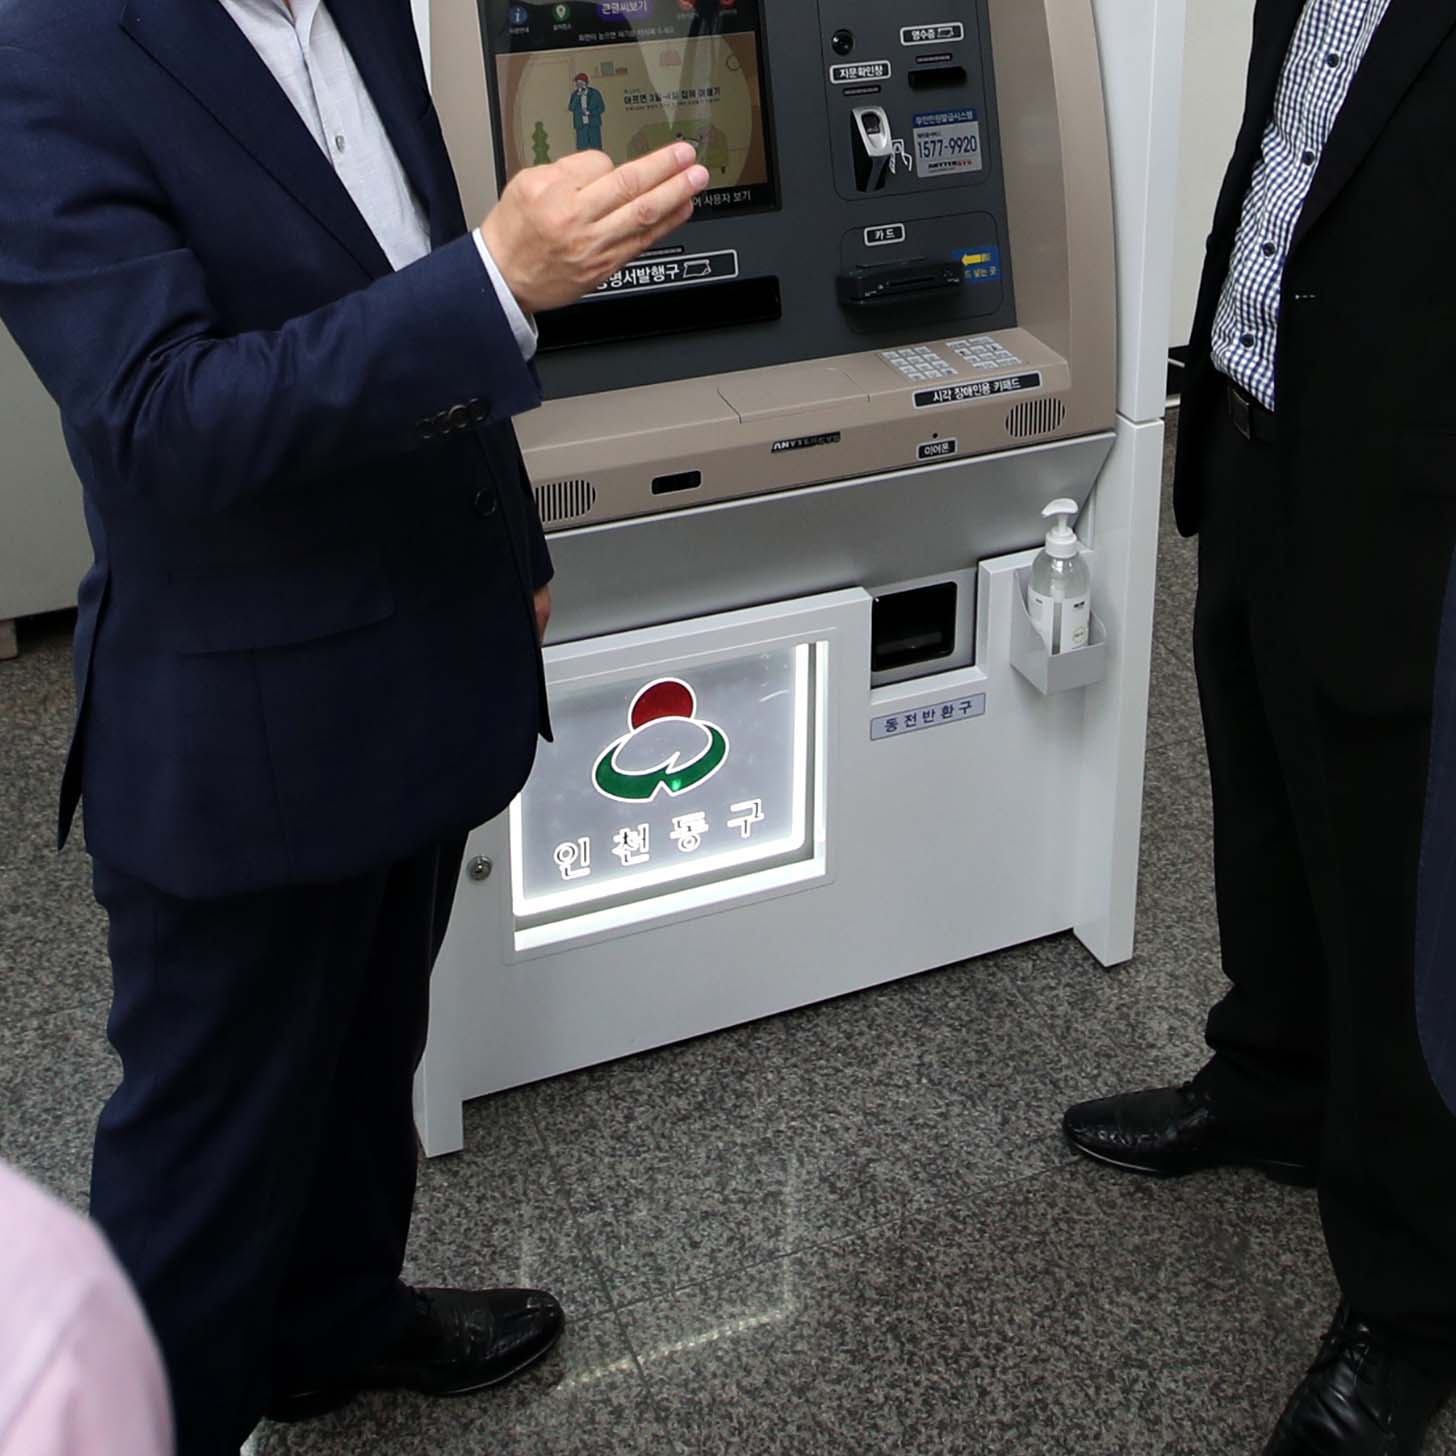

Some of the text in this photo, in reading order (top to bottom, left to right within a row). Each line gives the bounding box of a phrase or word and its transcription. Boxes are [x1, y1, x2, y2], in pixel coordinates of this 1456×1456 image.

[912, 29, 935, 40] 영수증
[840, 65, 883, 78] 지문확인창
[918, 135, 977, 158] 1577-9920
[705, 193, 731, 206] 사용자
[733, 191, 751, 202] 보기
[875, 229, 895, 240] 카드
[597, 264, 680, 289] 명서발행구
[933, 378, 1022, 402] 시각 장애인용 키패드
[924, 443, 949, 455] 이어폰
[884, 700, 972, 733] 동전반환구
